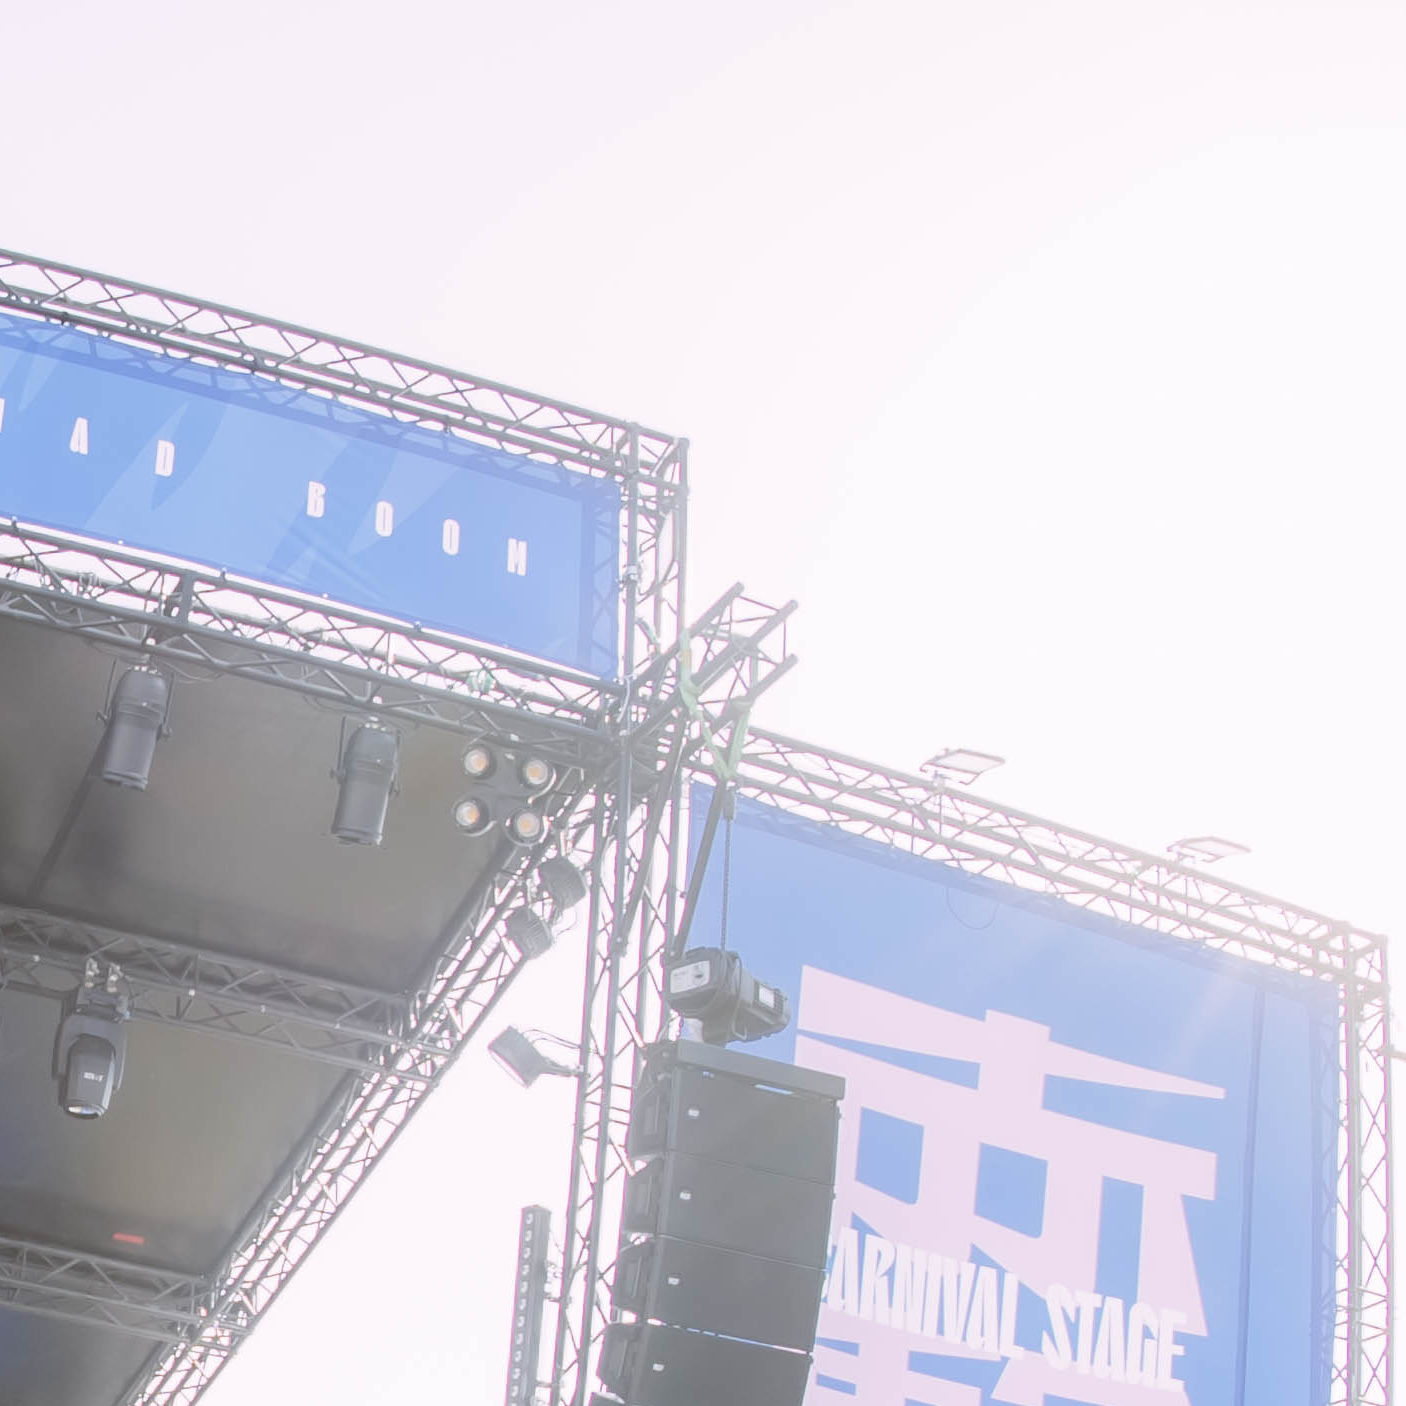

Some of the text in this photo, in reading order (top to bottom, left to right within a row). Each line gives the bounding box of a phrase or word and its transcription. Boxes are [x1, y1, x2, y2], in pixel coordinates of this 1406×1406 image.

[306, 480, 528, 576] BOOM
[821, 1226, 1188, 1393] ARNIVAL STAGE
